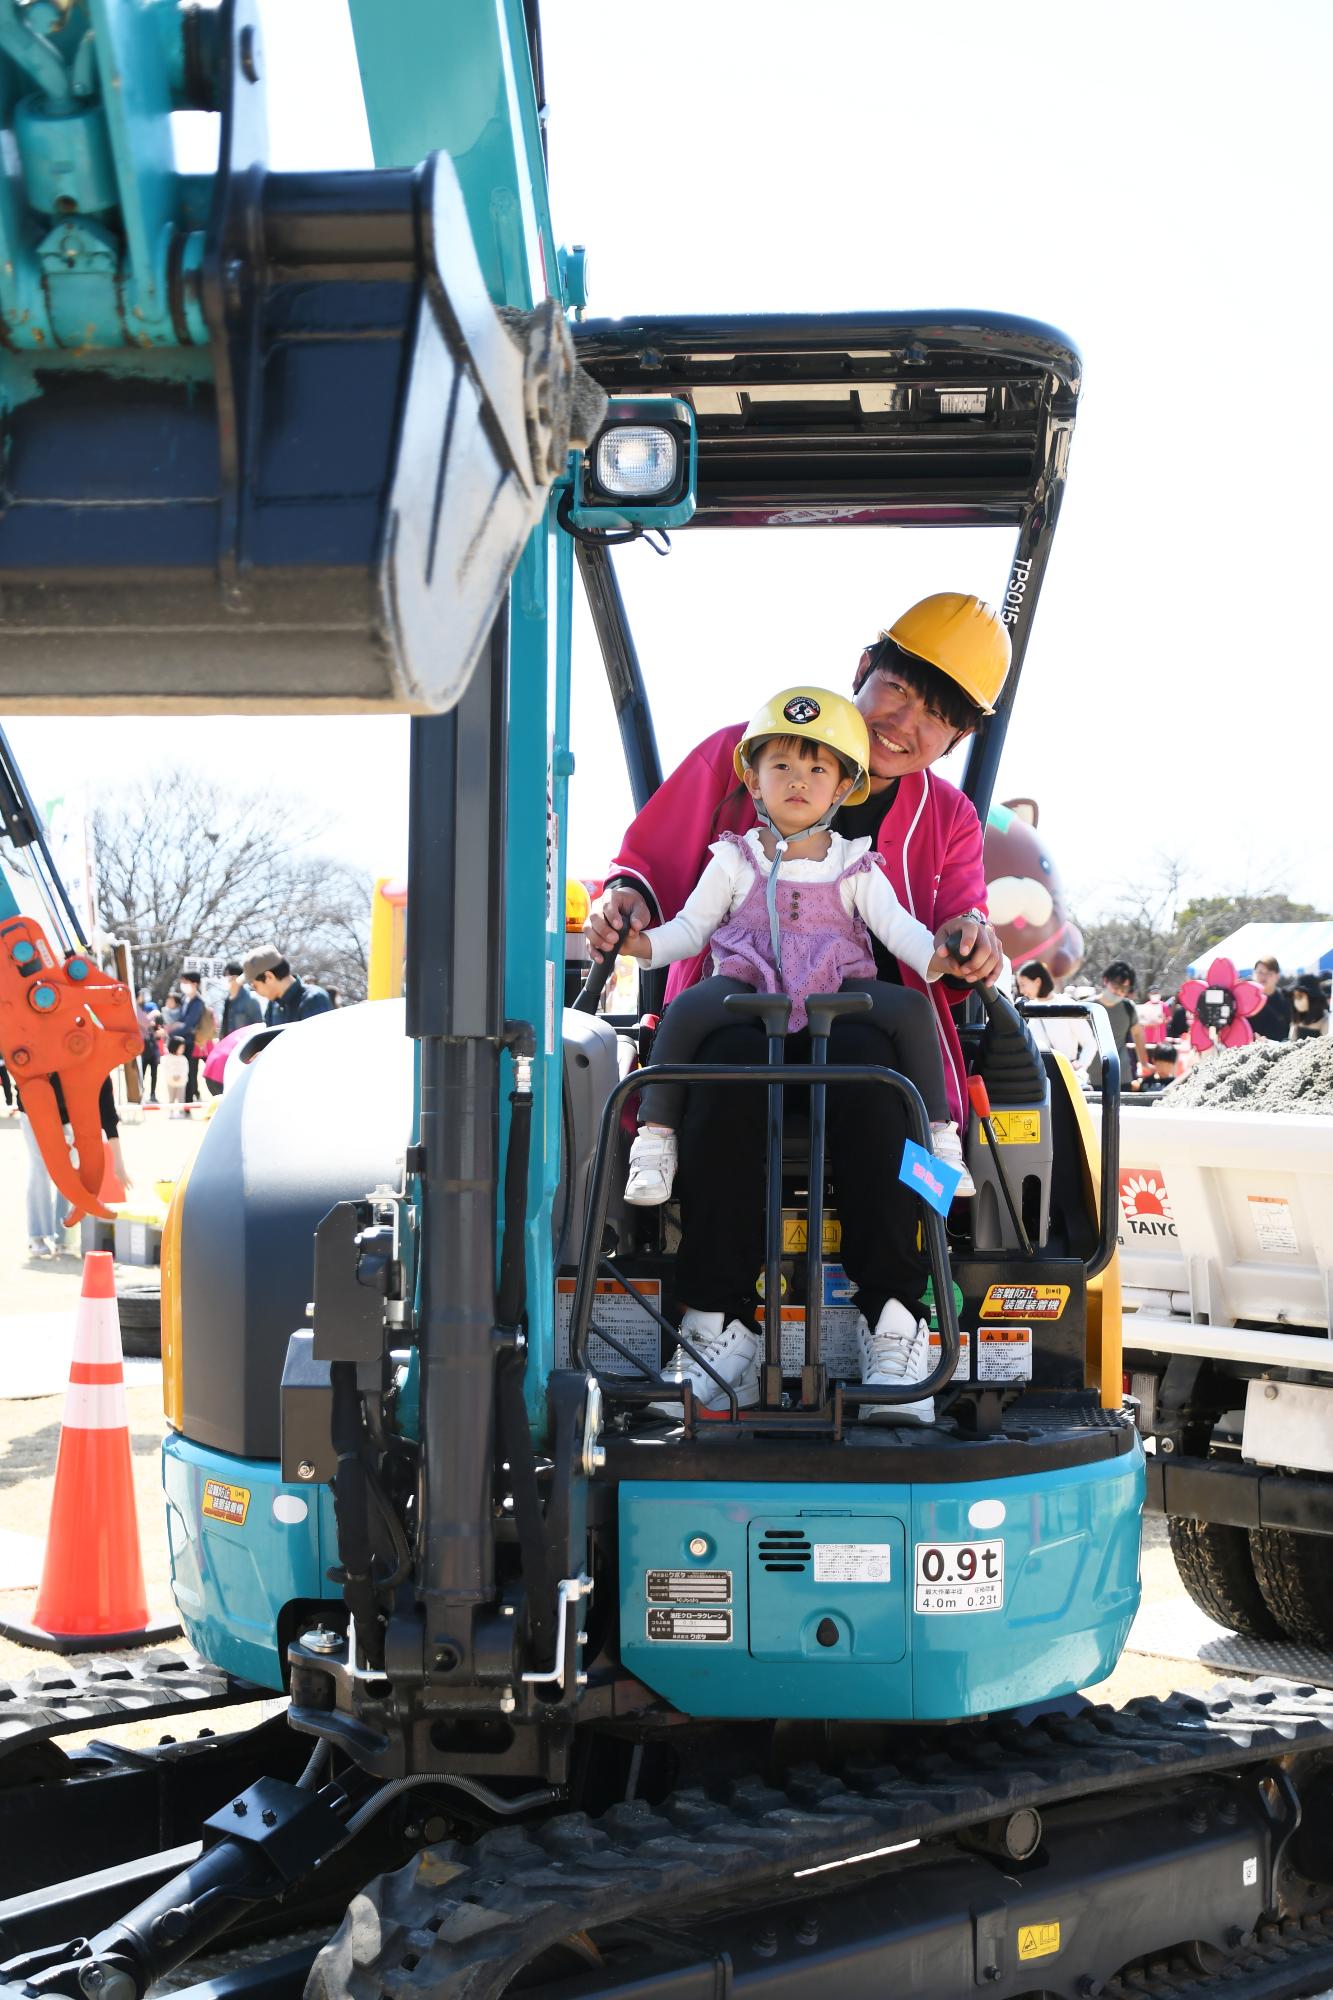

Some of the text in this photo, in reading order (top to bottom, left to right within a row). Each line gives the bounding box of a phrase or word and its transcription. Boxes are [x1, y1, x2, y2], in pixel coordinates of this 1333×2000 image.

[991, 1287, 1036, 1299] 盗難防止
[1003, 1299, 1060, 1311] 装置装着機
[922, 1548, 998, 1582] 0.9t
[922, 1594, 997, 1608] 4.0m 0.23t
